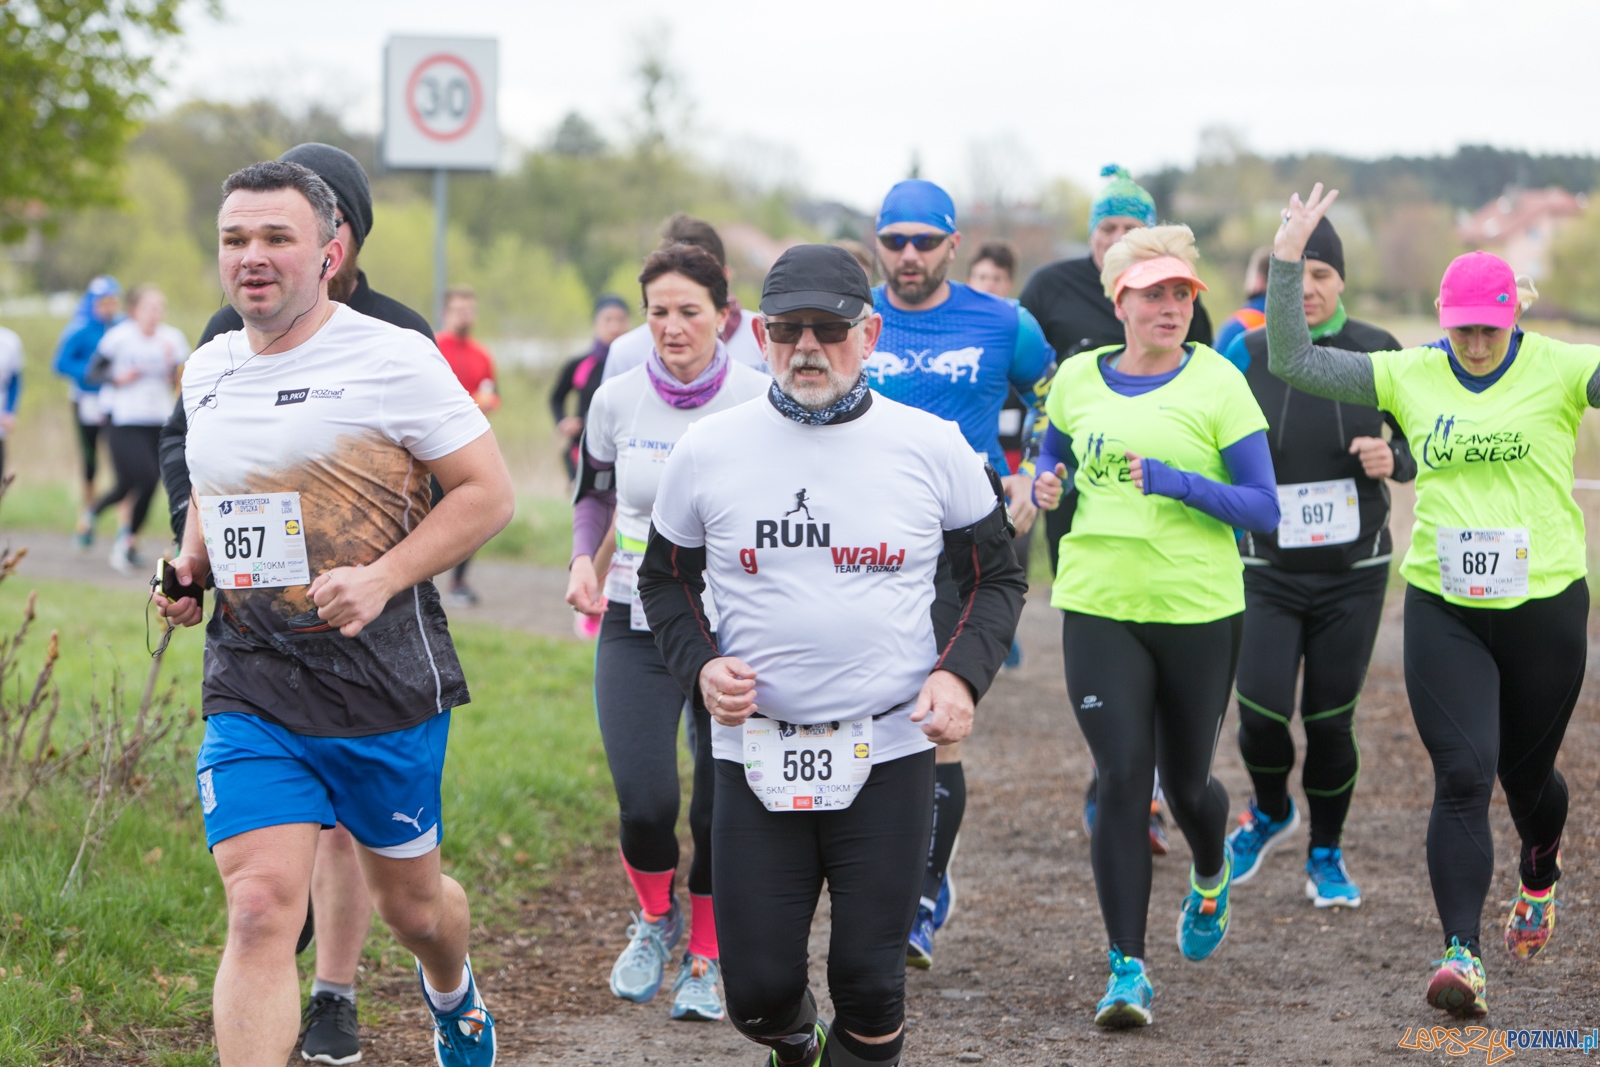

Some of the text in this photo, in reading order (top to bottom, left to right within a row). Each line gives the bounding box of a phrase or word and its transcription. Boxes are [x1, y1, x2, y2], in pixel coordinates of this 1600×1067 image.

[418, 77, 471, 119] 30
[290, 391, 306, 400] PKO
[1454, 432, 1522, 445] ZAWSZE
[1433, 444, 1530, 462] W BIEGU
[1302, 502, 1333, 525] 697
[224, 526, 266, 559] 857
[263, 561, 286, 570] 10KM
[835, 565, 860, 573] TEAM
[1463, 551, 1499, 575] 687
[783, 749, 832, 781] 583
[766, 786, 785, 794] 5KM
[826, 784, 851, 793] 10KM
